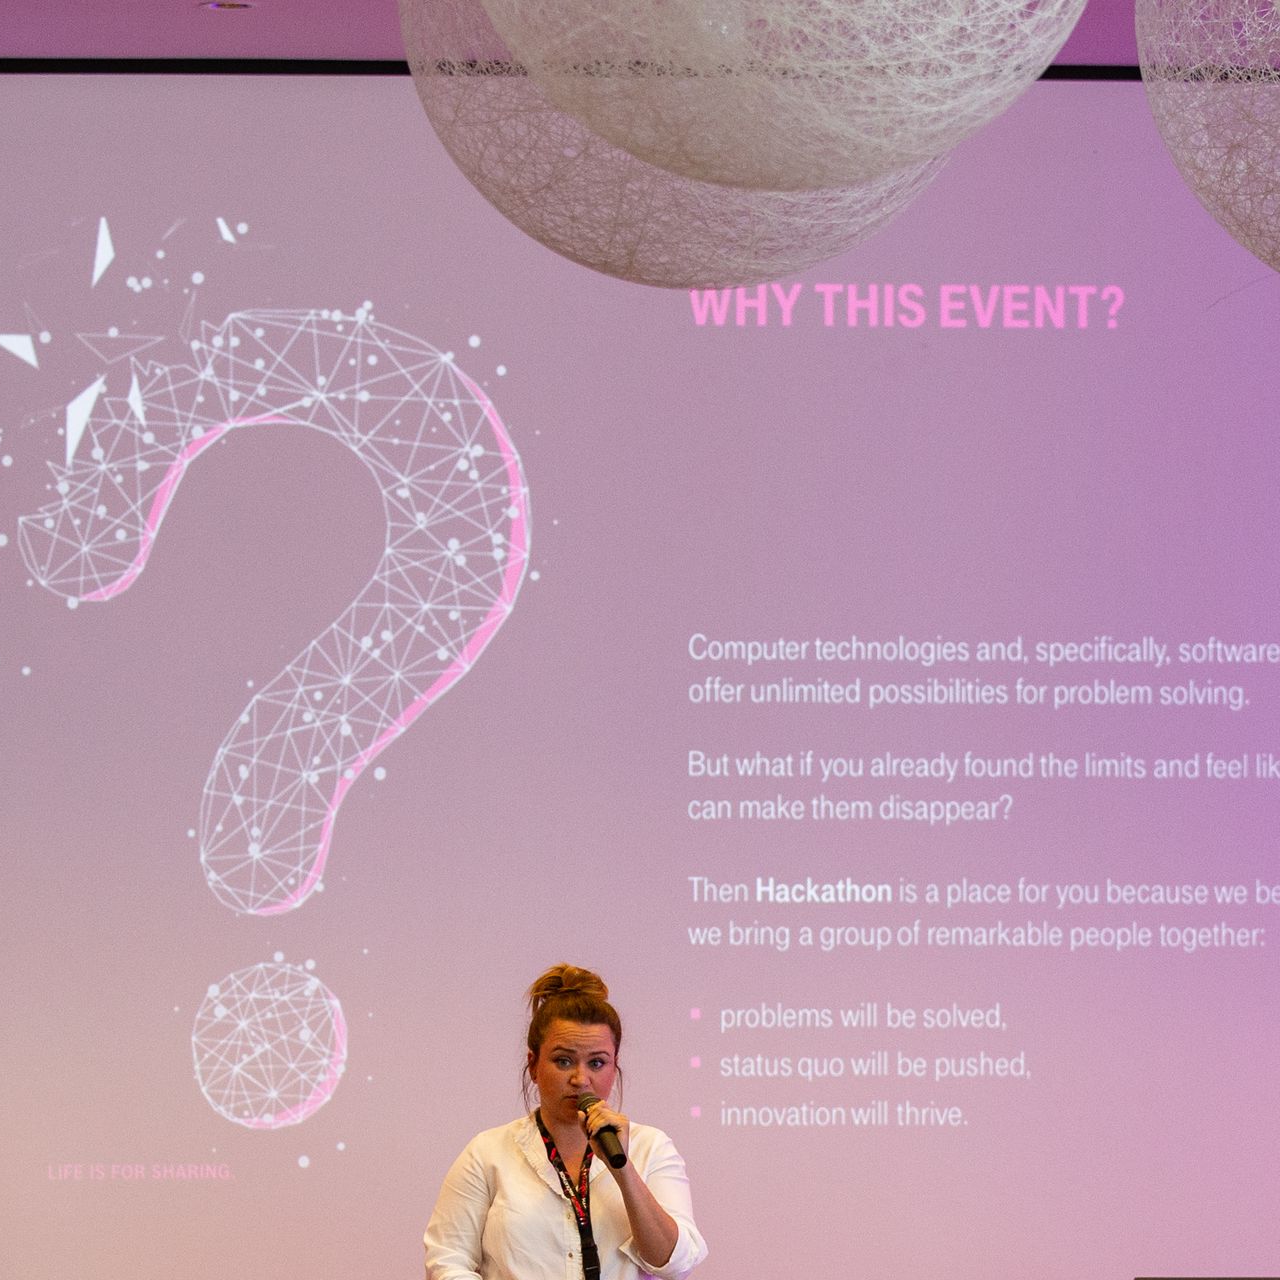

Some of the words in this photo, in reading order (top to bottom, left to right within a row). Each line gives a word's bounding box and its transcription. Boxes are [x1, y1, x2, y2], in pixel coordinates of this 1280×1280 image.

[689, 284, 803, 327] WHY
[814, 283, 927, 328] THIS
[939, 285, 1125, 330] EVENT?
[687, 632, 811, 666] Computer
[813, 634, 971, 667] technologies
[975, 635, 1029, 664] and,
[1035, 634, 1172, 668] specifically,
[688, 676, 745, 704] offer
[750, 677, 862, 704] unlimited
[868, 678, 1009, 709] possibilities
[1014, 677, 1048, 705] for
[1053, 679, 1153, 710] problem
[1159, 679, 1251, 712] solving.
[687, 749, 730, 778] But
[734, 750, 794, 778] what
[799, 749, 814, 777] if
[819, 757, 864, 783] you
[869, 751, 960, 783] already
[963, 750, 1035, 779] found
[1038, 752, 1079, 779] the
[1084, 752, 1147, 779] limits
[1153, 752, 1200, 779] and
[1205, 751, 1249, 779] feel
[687, 799, 732, 821] can
[738, 794, 806, 821] make
[810, 793, 873, 821] them
[878, 793, 1014, 826] disappear?
[687, 875, 749, 903] Then
[755, 876, 893, 904] Hackathon
[899, 877, 918, 904] is
[925, 883, 940, 904] a
[946, 877, 1012, 908] place
[1017, 876, 1050, 904] for
[1055, 884, 1100, 909] you
[1106, 878, 1209, 905] because
[1213, 884, 1248, 905] we
[687, 926, 723, 947] we
[728, 920, 791, 952] bring
[798, 925, 814, 947] a
[819, 925, 893, 952] group
[896, 919, 921, 947] of
[927, 920, 1064, 947] remarkable
[1069, 921, 1153, 952] people
[1159, 921, 1266, 953] together:
[720, 1001, 834, 1034] problems
[839, 1002, 878, 1028] will
[886, 1002, 917, 1029] be
[922, 1002, 1007, 1031] solved,
[719, 1053, 794, 1078] status
[797, 1056, 845, 1082] quo
[850, 1050, 889, 1077] will
[896, 1050, 928, 1078] be
[934, 1050, 1032, 1082] pushed,
[720, 1100, 847, 1127] innovation
[850, 1099, 889, 1126] will
[896, 1100, 969, 1127] thrive.
[47, 1163, 83, 1181] LIFE
[89, 1163, 106, 1181] IS
[110, 1163, 146, 1181] FOR
[151, 1163, 235, 1181] SHARING.
